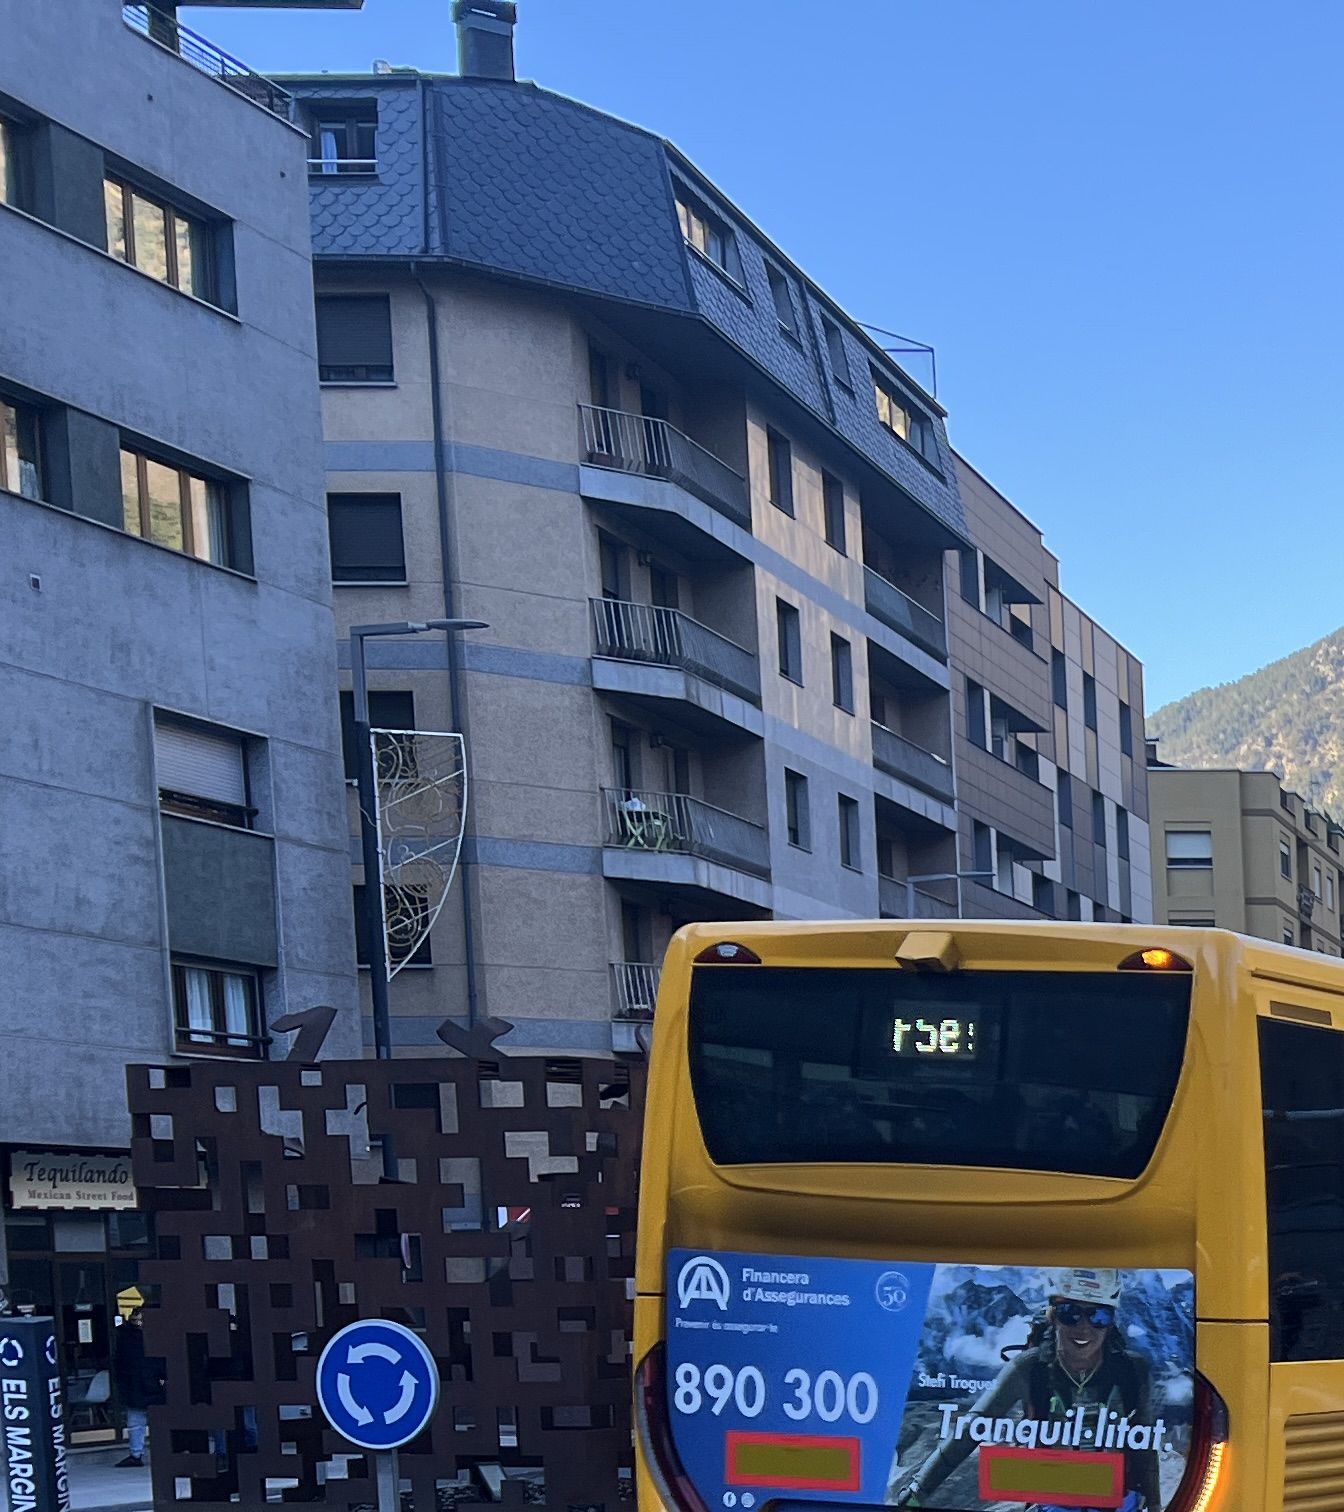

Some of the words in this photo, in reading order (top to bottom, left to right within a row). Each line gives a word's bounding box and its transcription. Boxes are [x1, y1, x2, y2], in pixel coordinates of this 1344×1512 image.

[24, 1161, 128, 1189] Tequilando
[28, 1189, 72, 1200] Mexican
[76, 1190, 107, 1201] Street
[111, 1191, 134, 1202] Food
[742, 1267, 810, 1285] Financera
[742, 1287, 851, 1307] d'Assegurances
[2, 1378, 30, 1421] ELS
[674, 1362, 766, 1418] 890
[782, 1368, 879, 1424] 300
